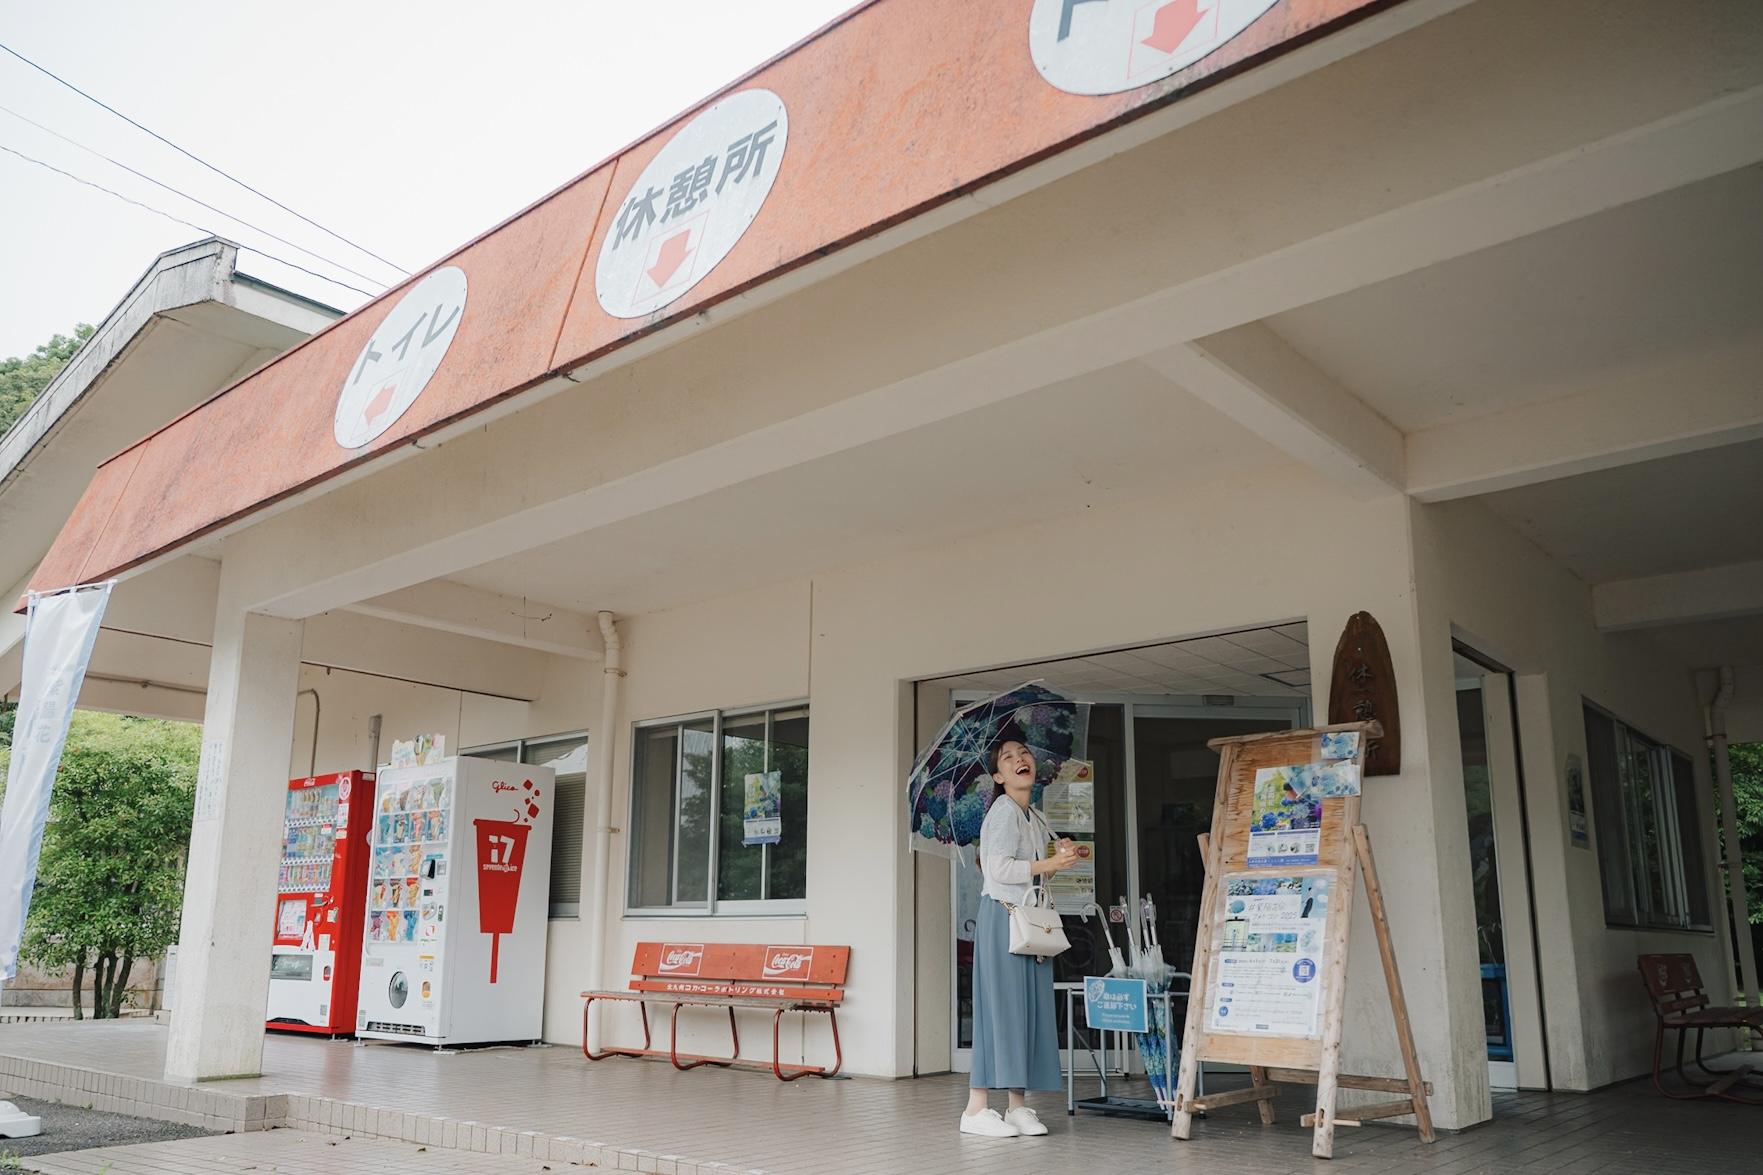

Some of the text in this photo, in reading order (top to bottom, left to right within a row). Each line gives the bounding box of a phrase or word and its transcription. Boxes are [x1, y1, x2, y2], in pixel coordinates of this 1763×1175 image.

[612, 120, 778, 250] 休憩所
[353, 304, 460, 385] トイレ
[492, 781, 518, 793] Glico
